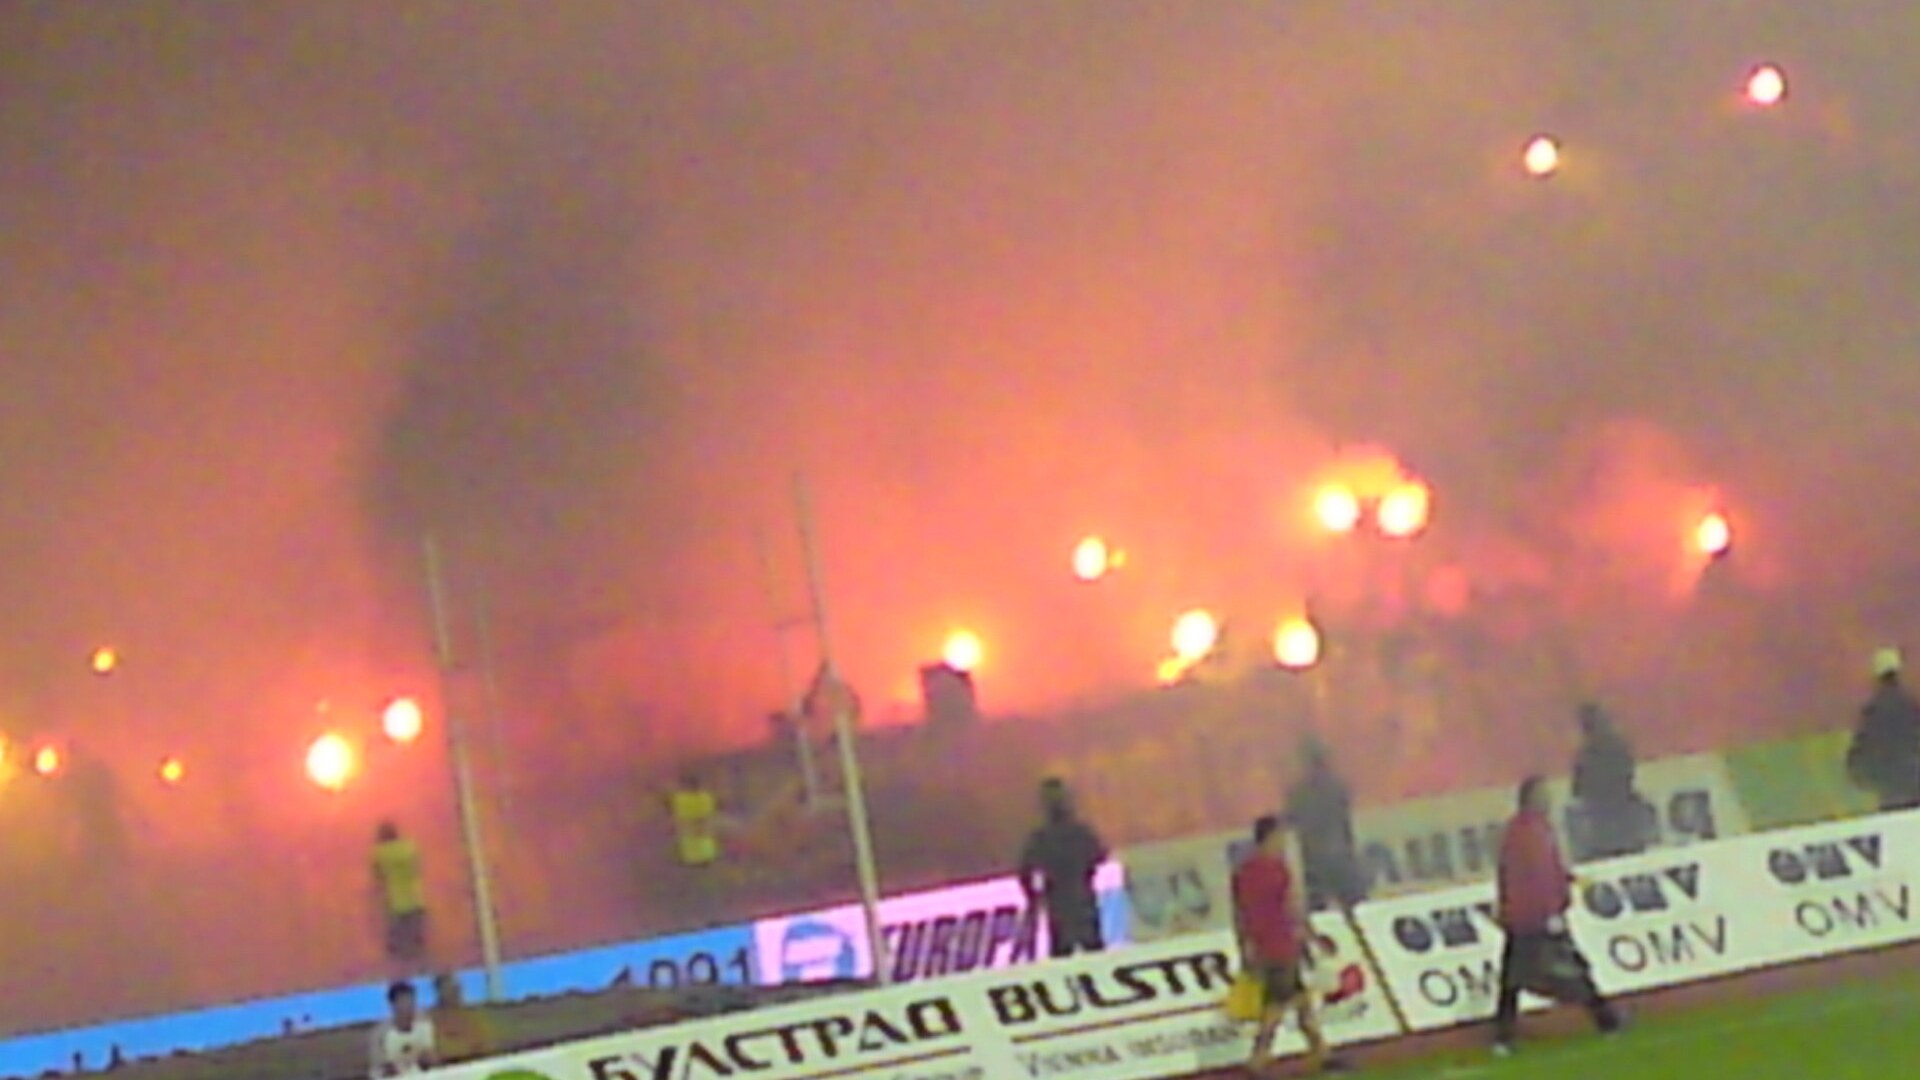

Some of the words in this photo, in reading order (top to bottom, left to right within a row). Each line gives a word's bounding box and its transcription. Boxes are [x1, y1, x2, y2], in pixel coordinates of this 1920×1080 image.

[1796, 884, 1909, 936] OMV
[1608, 914, 1725, 971] OMV
[987, 950, 1237, 1025] BULSTR
[1418, 958, 1497, 1007] OM
